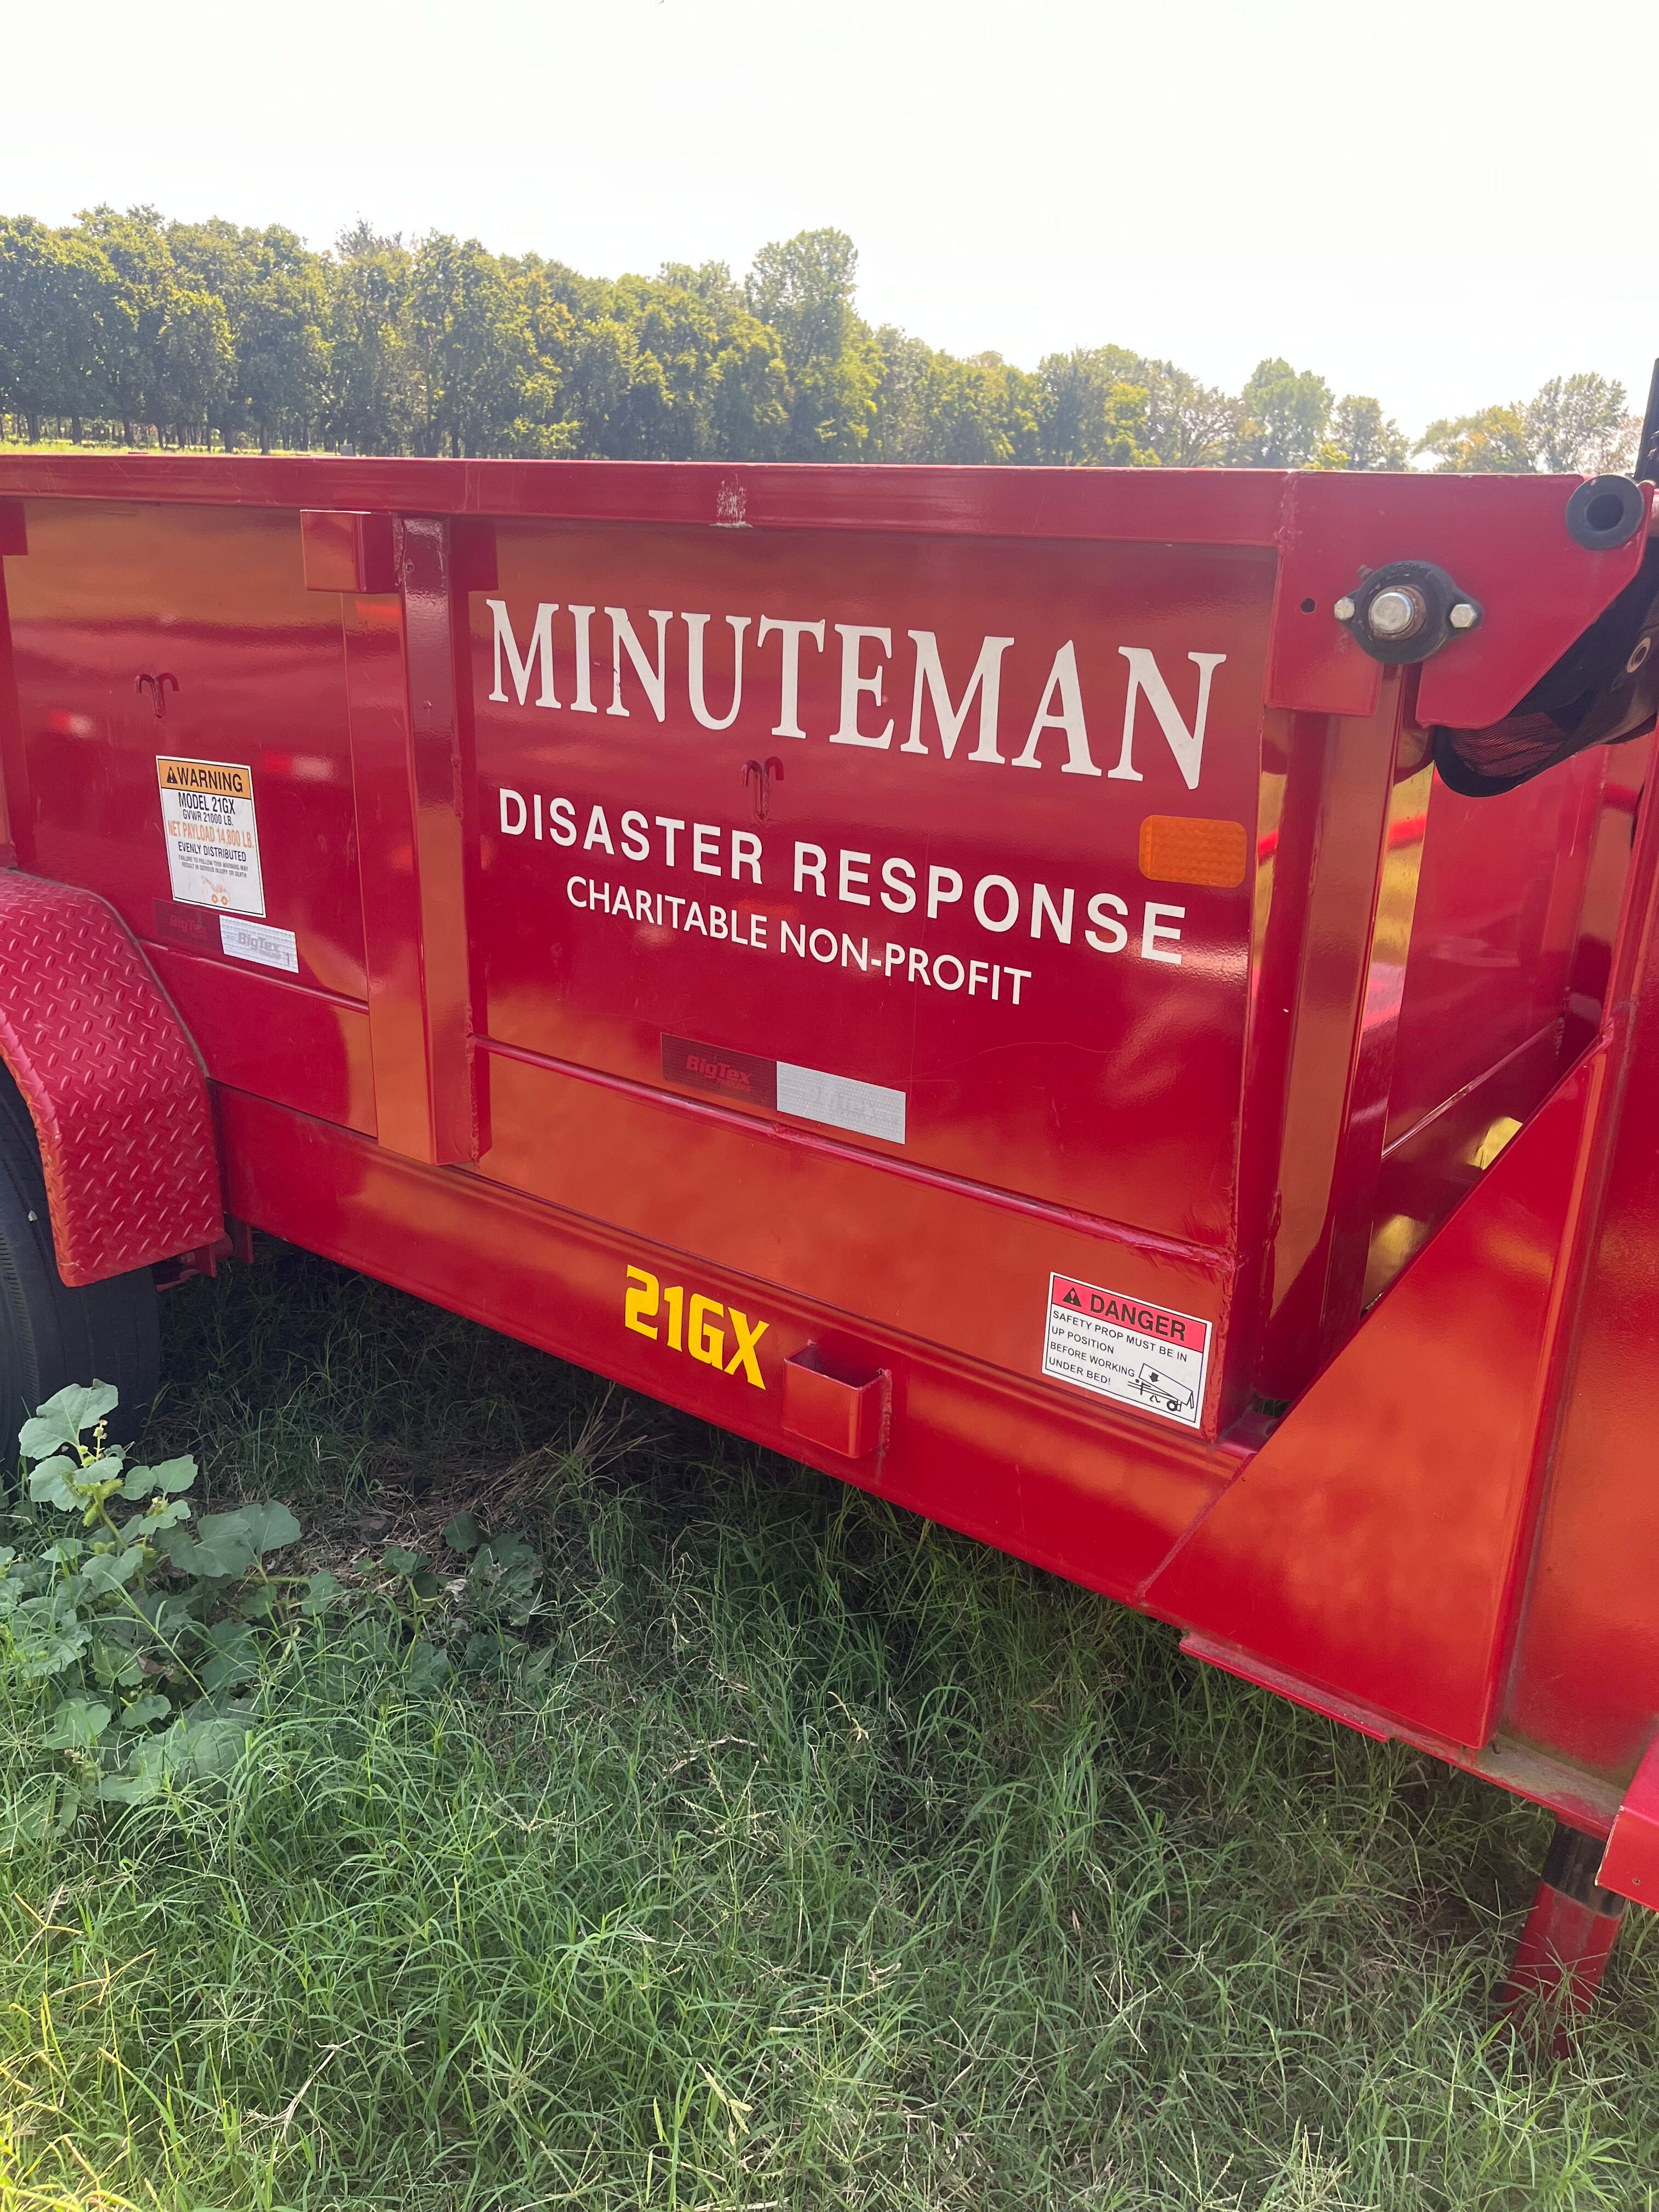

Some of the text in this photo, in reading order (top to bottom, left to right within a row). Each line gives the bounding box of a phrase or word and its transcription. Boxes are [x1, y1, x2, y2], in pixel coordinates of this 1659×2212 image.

[486, 598, 1226, 789] MINUTEMAN
[177, 767, 243, 792] WARNING
[178, 792, 236, 815] MODEL 21GX
[183, 809, 234, 826] GVWR 21000 LB.
[168, 820, 254, 849] NET PAYLOAD 14,800 LB.
[178, 841, 246, 862] EVENLY DISTRIBUTED
[499, 788, 1186, 964] DISASTER RESPONSE
[238, 932, 280, 953] BigTex
[566, 876, 1032, 1005] CHARITABLE NON-PROFIT
[686, 1054, 751, 1085] BigTex
[625, 1264, 770, 1390] 21GX
[1090, 1294, 1186, 1341] DANGER
[1052, 1326, 1114, 1354] UP POSITION
[1053, 1311, 1187, 1362] SAFETY PROP MUST BE IN
[1049, 1357, 1110, 1385] UNDER BED!
[1050, 1341, 1135, 1377] BEFORE WORKING
